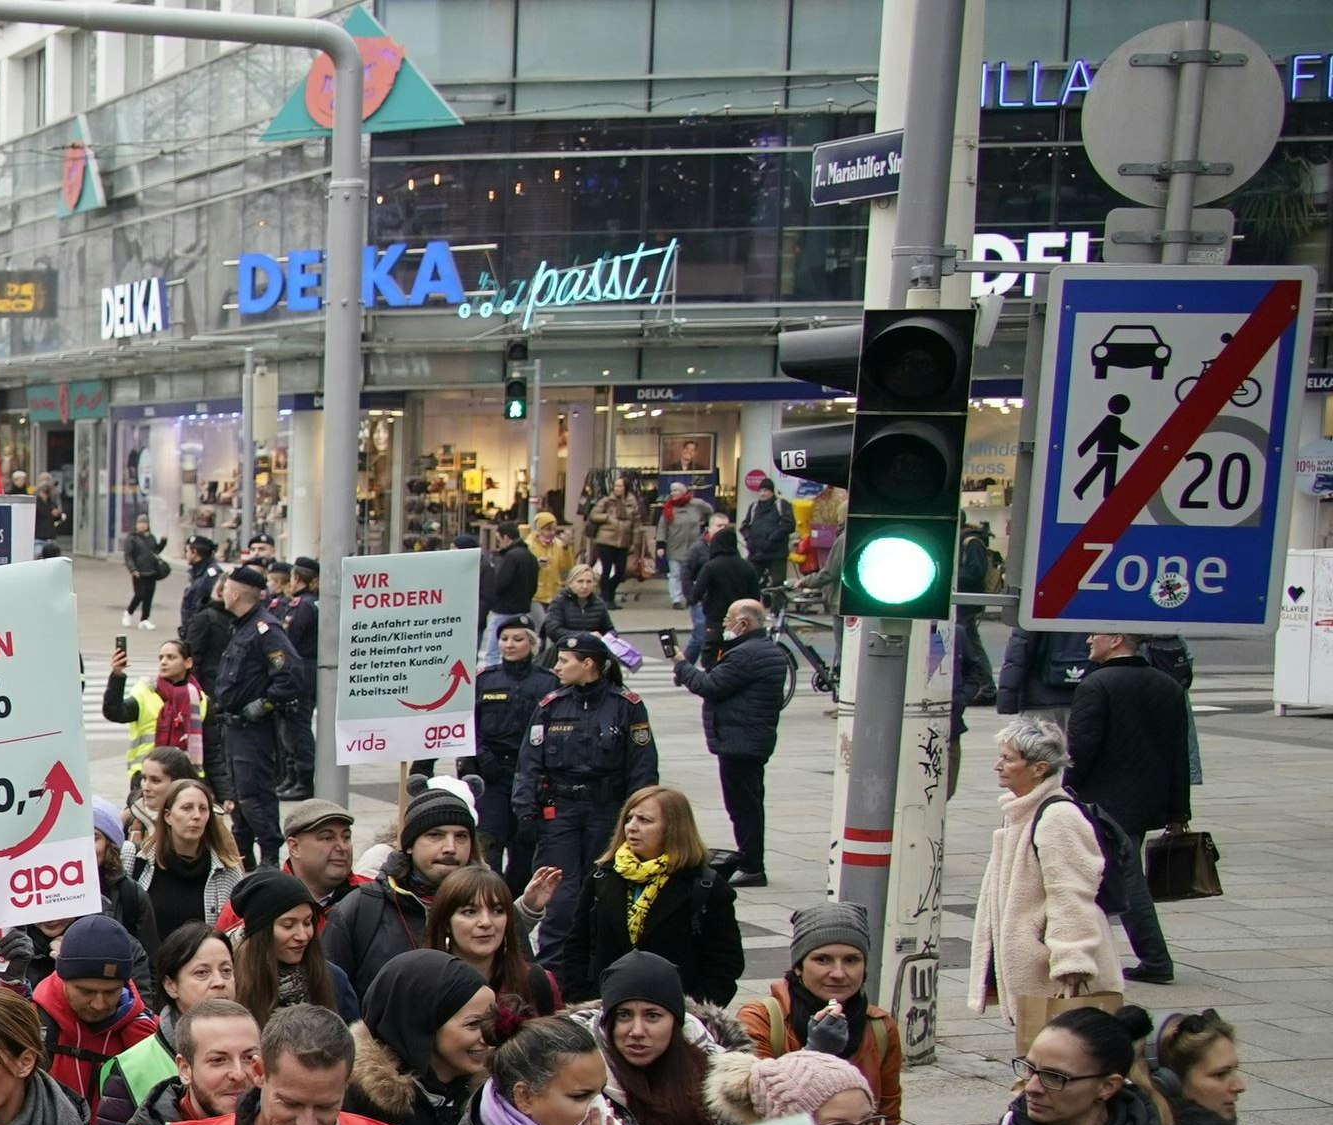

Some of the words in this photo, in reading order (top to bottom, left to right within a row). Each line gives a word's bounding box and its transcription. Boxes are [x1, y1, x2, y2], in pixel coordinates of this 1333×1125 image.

[827, 156, 886, 185] Mariahilfer
[238, 241, 466, 314] DEKA
[100, 277, 166, 340] DELKA
[637, 389, 674, 400] DELKA
[783, 452, 805, 468] 16
[1296, 461, 1316, 473] 10%
[1180, 451, 1250, 510] 20
[353, 573, 389, 589] WIR
[352, 589, 442, 609] FORDERN
[352, 621, 368, 630] die
[371, 619, 411, 630] Anfahrt
[413, 618, 429, 627] zur
[432, 615, 462, 625] ersten
[351, 631, 432, 644] Kundin/Klientin
[435, 629, 453, 638] und
[350, 647, 367, 657] die
[369, 645, 422, 656] Heimfahrt
[424, 644, 442, 653] von
[350, 661, 368, 671] der
[370, 659, 406, 669] letzten
[409, 655, 449, 667] Kundin/
[349, 674, 389, 684] Klientin
[392, 672, 407, 682] als
[348, 685, 409, 697] Arbeitszeit!
[346, 733, 386, 752] vida
[424, 723, 465, 749] gpa
[10, 860, 85, 908] gpa
